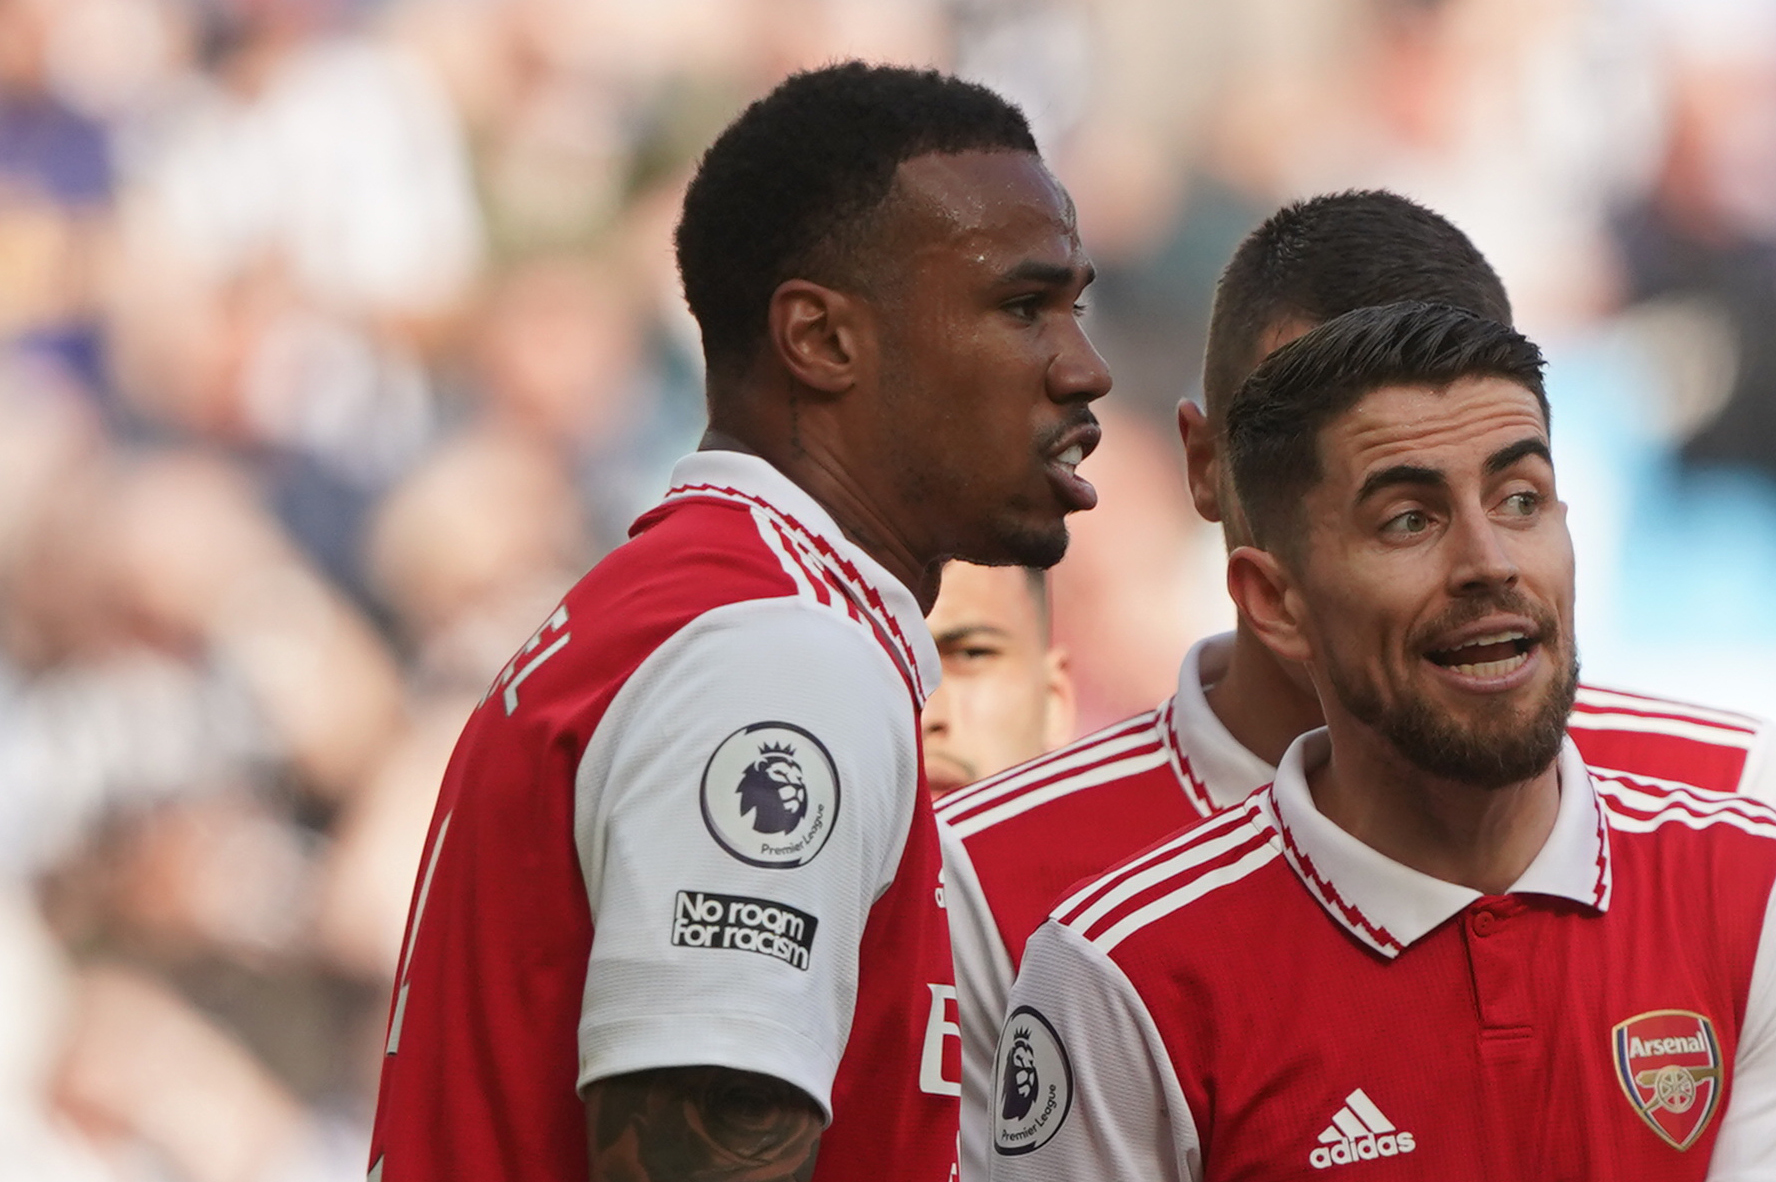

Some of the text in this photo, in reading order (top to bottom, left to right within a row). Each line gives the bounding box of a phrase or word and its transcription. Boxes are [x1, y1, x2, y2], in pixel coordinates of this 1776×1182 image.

[761, 803, 825, 856] Premier League
[676, 891, 805, 941] No room
[672, 918, 809, 970] for racism
[1630, 1031, 1706, 1059] Arsenal
[1001, 1084, 1057, 1141] Premier League
[1309, 1131, 1416, 1169] adidas
